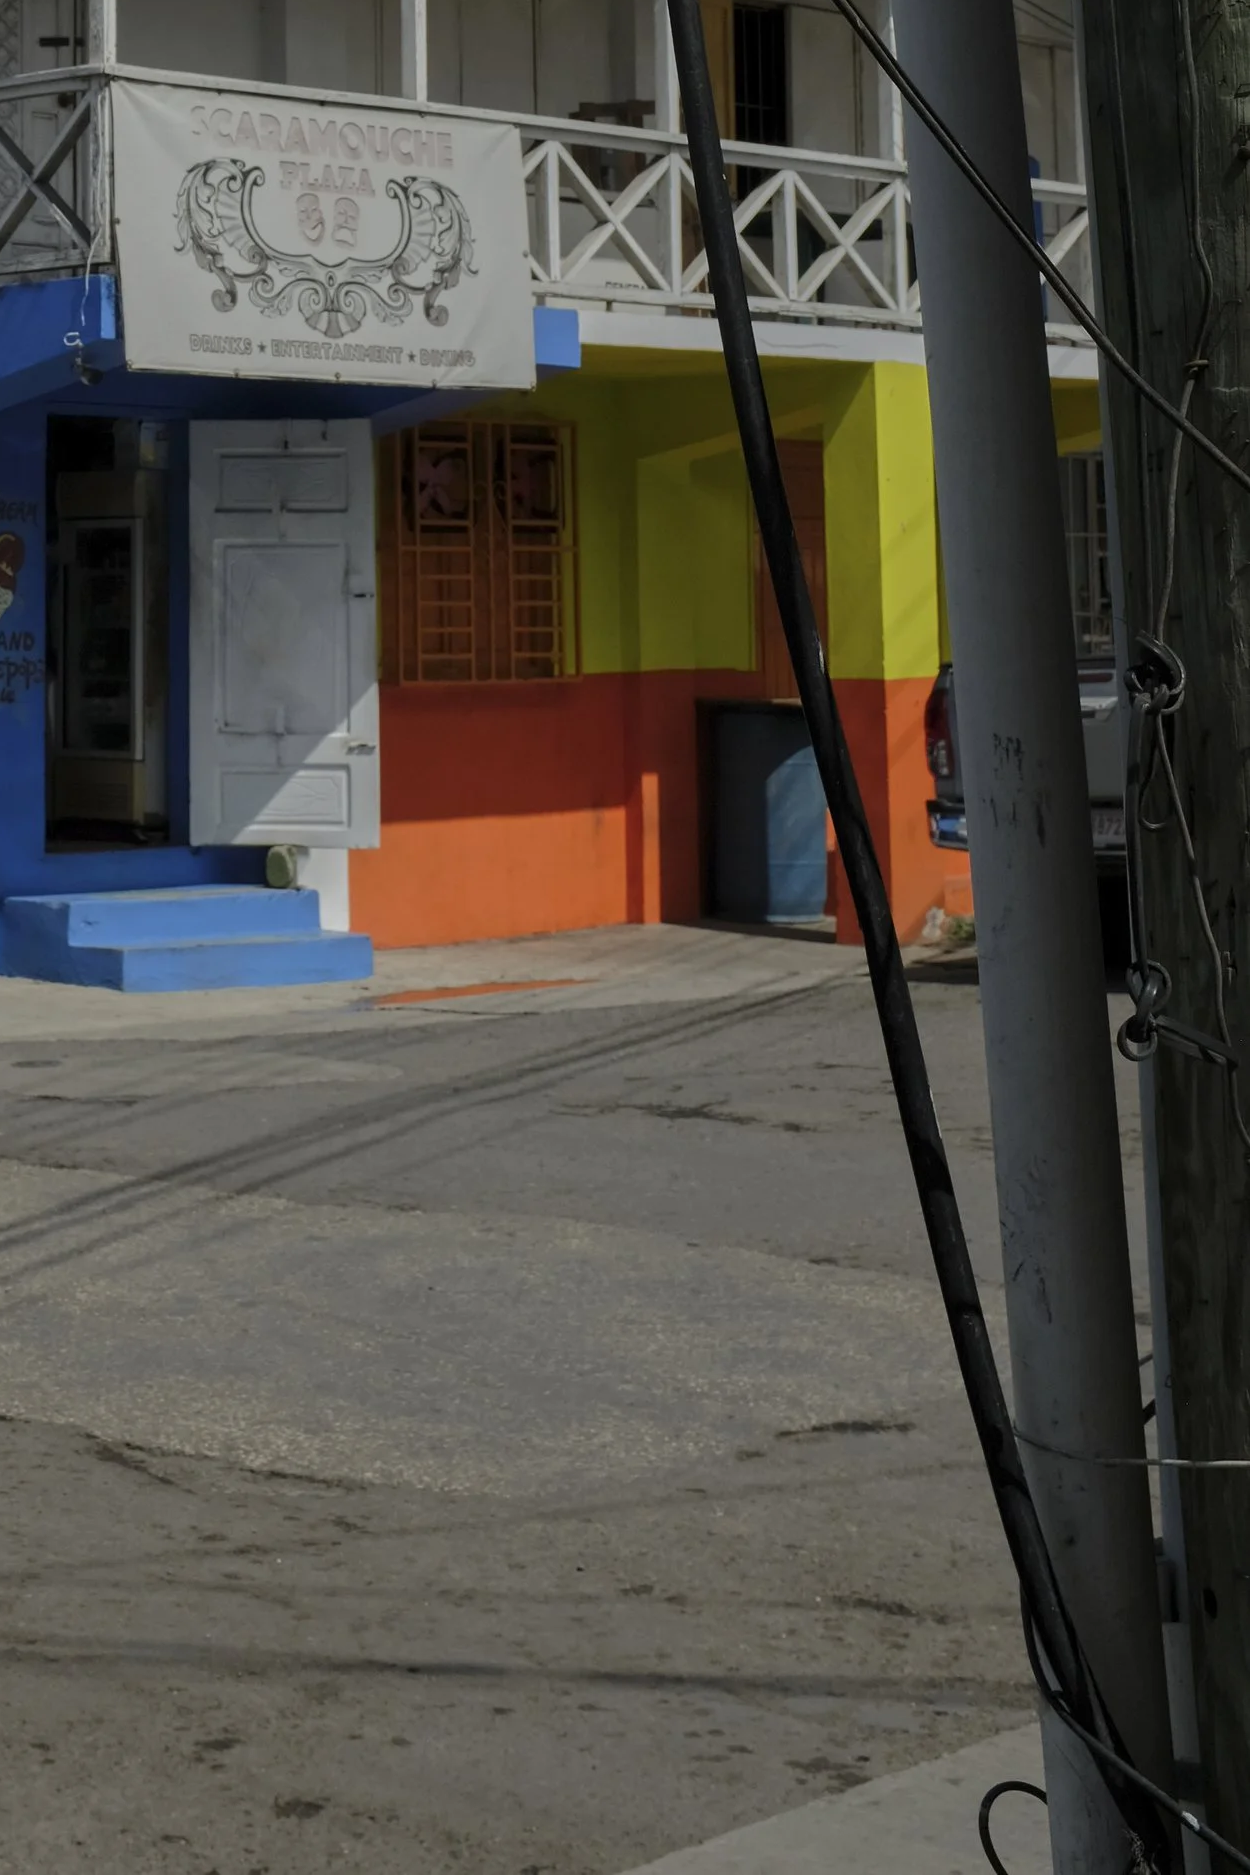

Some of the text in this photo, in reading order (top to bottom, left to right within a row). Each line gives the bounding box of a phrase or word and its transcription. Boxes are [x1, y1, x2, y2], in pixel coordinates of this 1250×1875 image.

[190, 105, 454, 170] SCARAMOUCHE
[279, 161, 376, 198] PLAZA
[189, 333, 476, 367] DRINKS ENTERTAINMENT DINING
